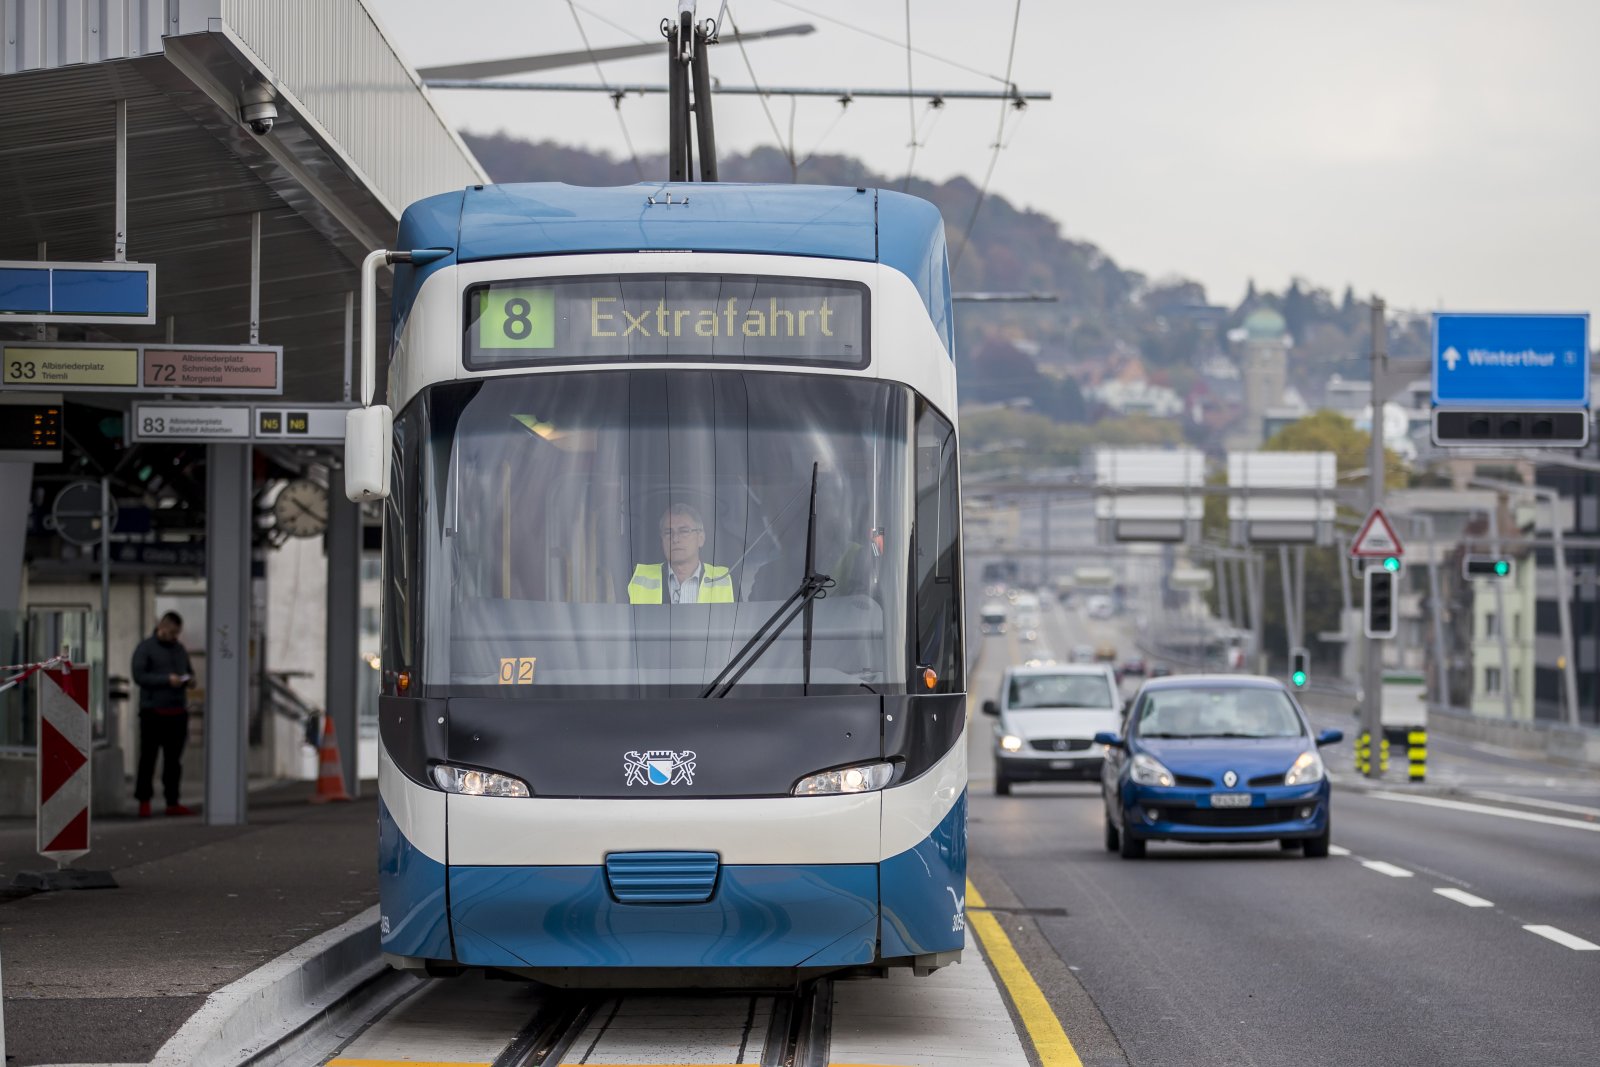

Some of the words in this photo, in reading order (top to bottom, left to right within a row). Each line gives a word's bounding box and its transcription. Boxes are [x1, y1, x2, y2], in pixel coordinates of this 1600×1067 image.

[503, 298, 532, 340] 8
[591, 297, 834, 337] Extrafahrt
[182, 354, 244, 363] Albisriederplatz
[1467, 348, 1555, 367] Winterthur
[10, 361, 36, 379] 33
[41, 362, 104, 371] Albisriederplatz
[182, 364, 222, 373] Schmiede
[224, 365, 261, 373] Wiedikon
[42, 372, 68, 380] Triemli
[151, 364, 176, 382] 72
[182, 374, 223, 383] Morgental
[143, 417, 165, 433] 83
